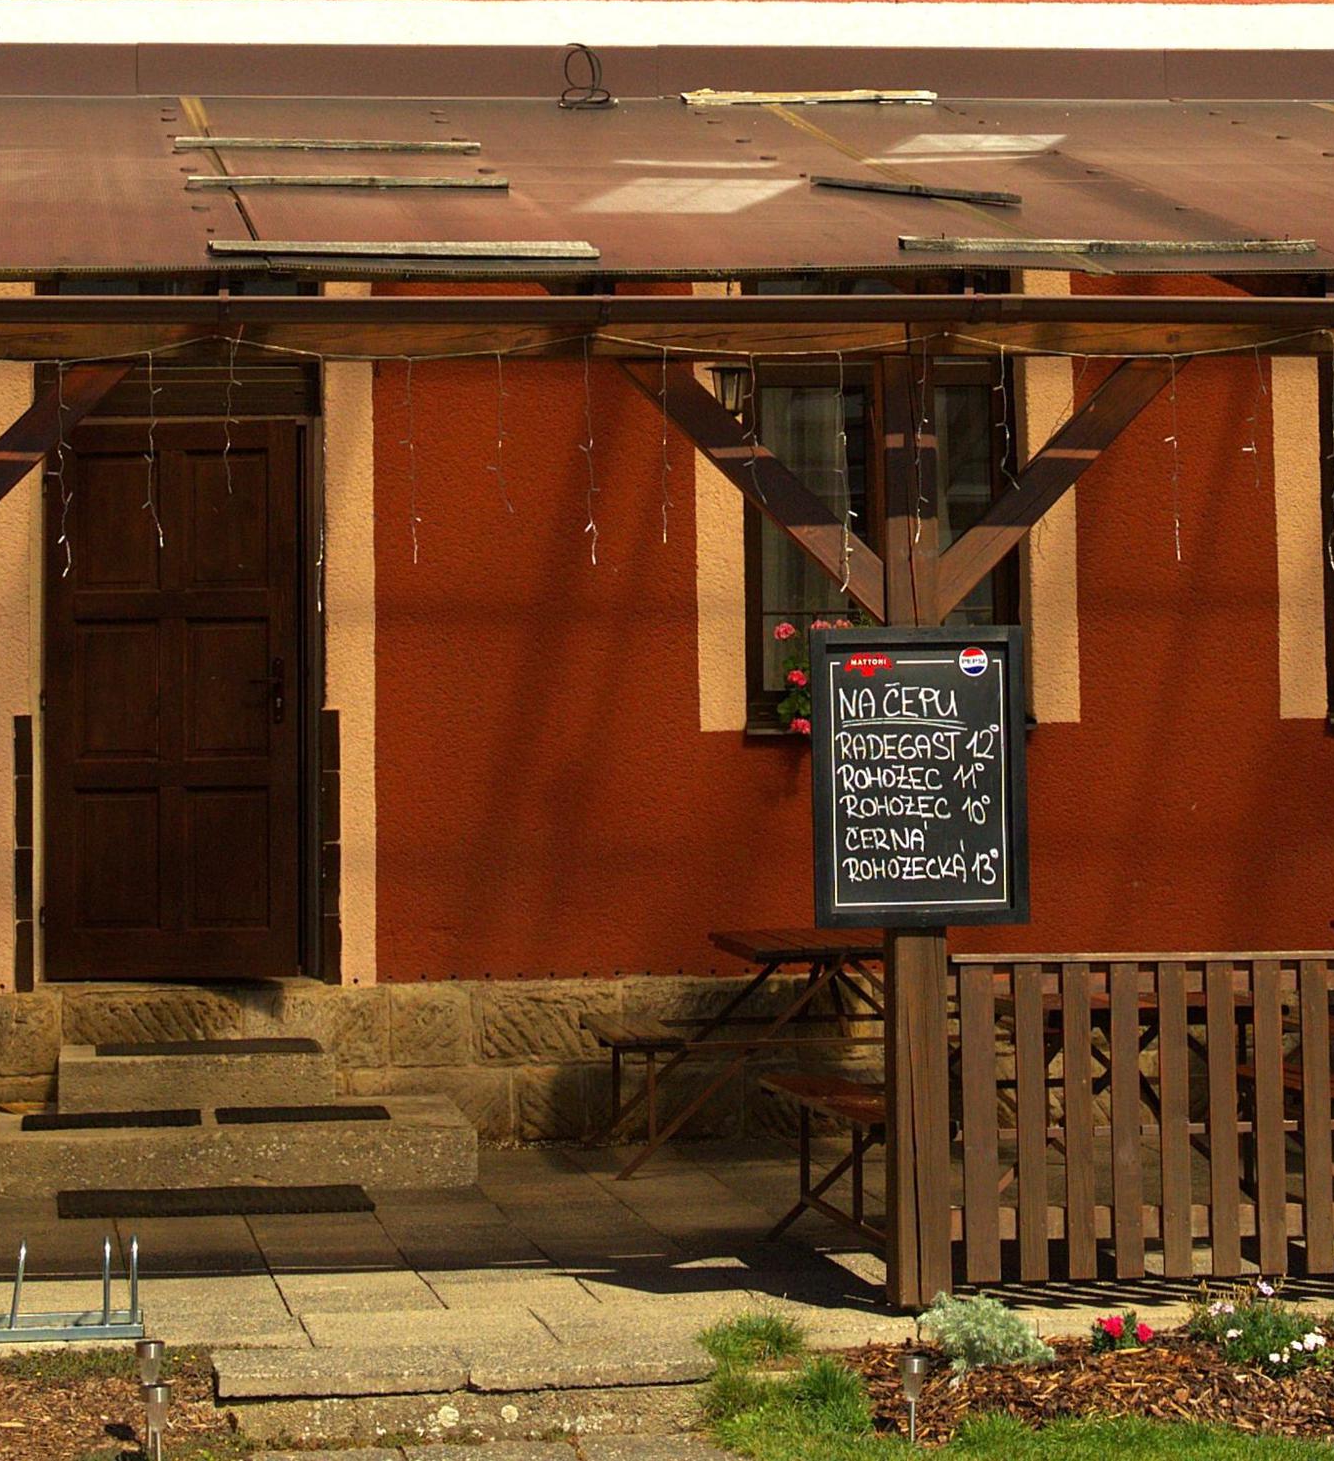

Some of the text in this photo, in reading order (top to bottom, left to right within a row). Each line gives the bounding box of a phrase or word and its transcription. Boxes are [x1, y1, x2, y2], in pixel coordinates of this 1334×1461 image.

[850, 658, 887, 666] MATTONI
[961, 657, 987, 665] PEPSI
[839, 682, 958, 720] NA ČEPU
[835, 731, 962, 762] RADEGAST
[836, 764, 943, 792] ROHOZEC
[839, 794, 952, 820] ROHOZEC
[845, 820, 928, 852] ČERNÁ
[842, 839, 967, 884] ROHOZECKÁ
